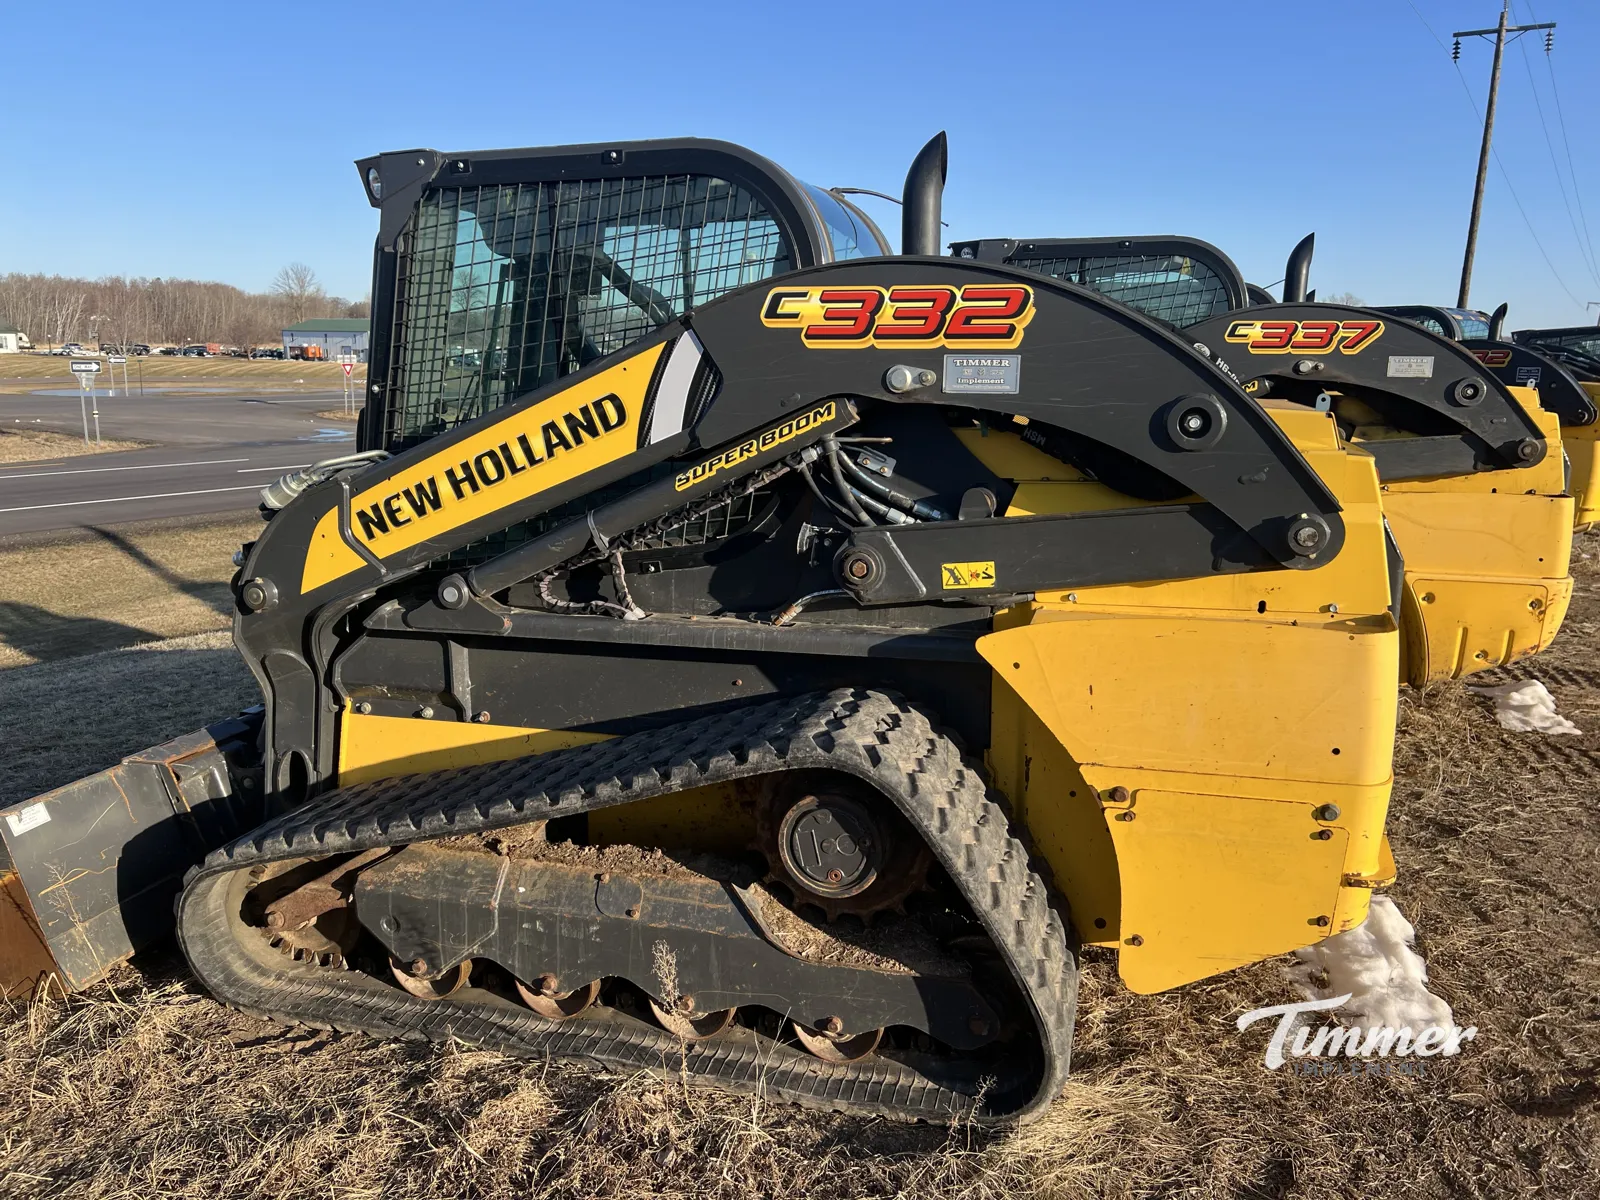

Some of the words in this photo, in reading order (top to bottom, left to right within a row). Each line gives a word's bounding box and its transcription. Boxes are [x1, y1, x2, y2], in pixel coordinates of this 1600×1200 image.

[953, 359, 1010, 367] TIMMER
[957, 377, 1005, 385] Implement
[356, 475, 444, 541] NEW
[444, 392, 628, 501] HOLLAND
[675, 439, 758, 491] SUPER
[759, 401, 836, 451] BOOM
